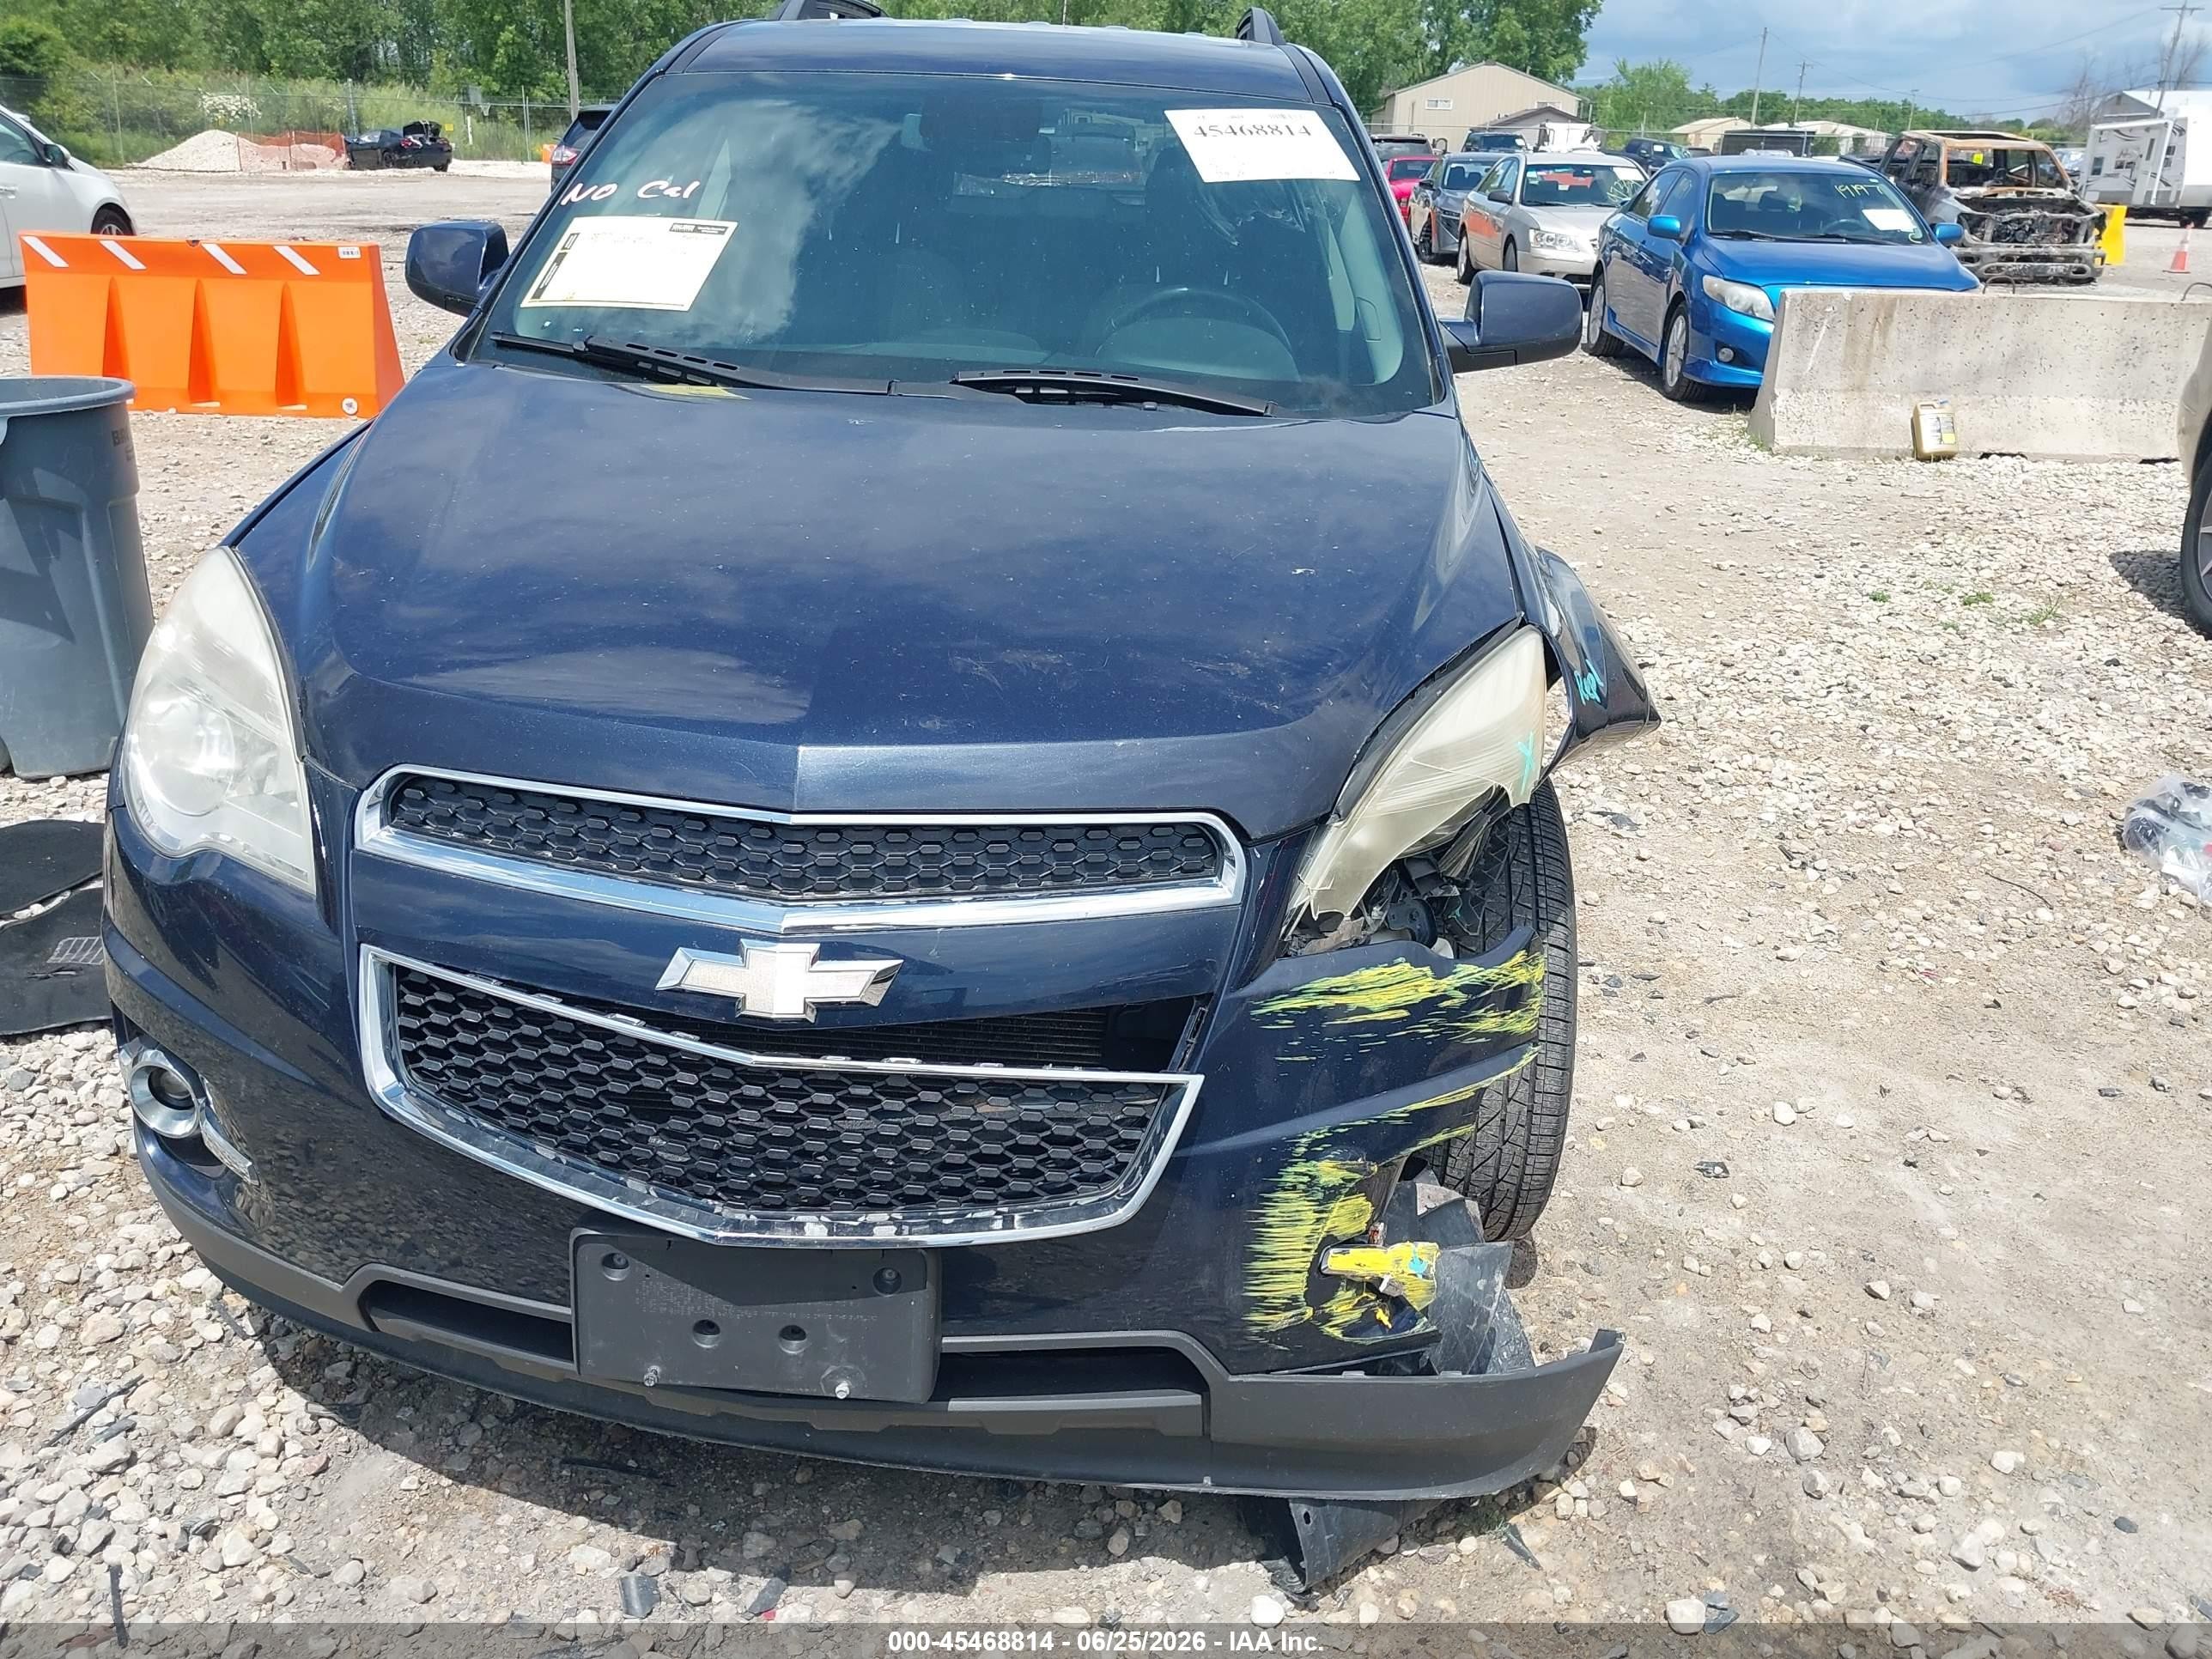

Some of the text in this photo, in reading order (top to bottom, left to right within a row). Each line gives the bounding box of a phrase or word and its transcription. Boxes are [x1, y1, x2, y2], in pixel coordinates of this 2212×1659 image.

[1194, 124, 1312, 137] 45468814
[560, 180, 701, 206] NO Cal
